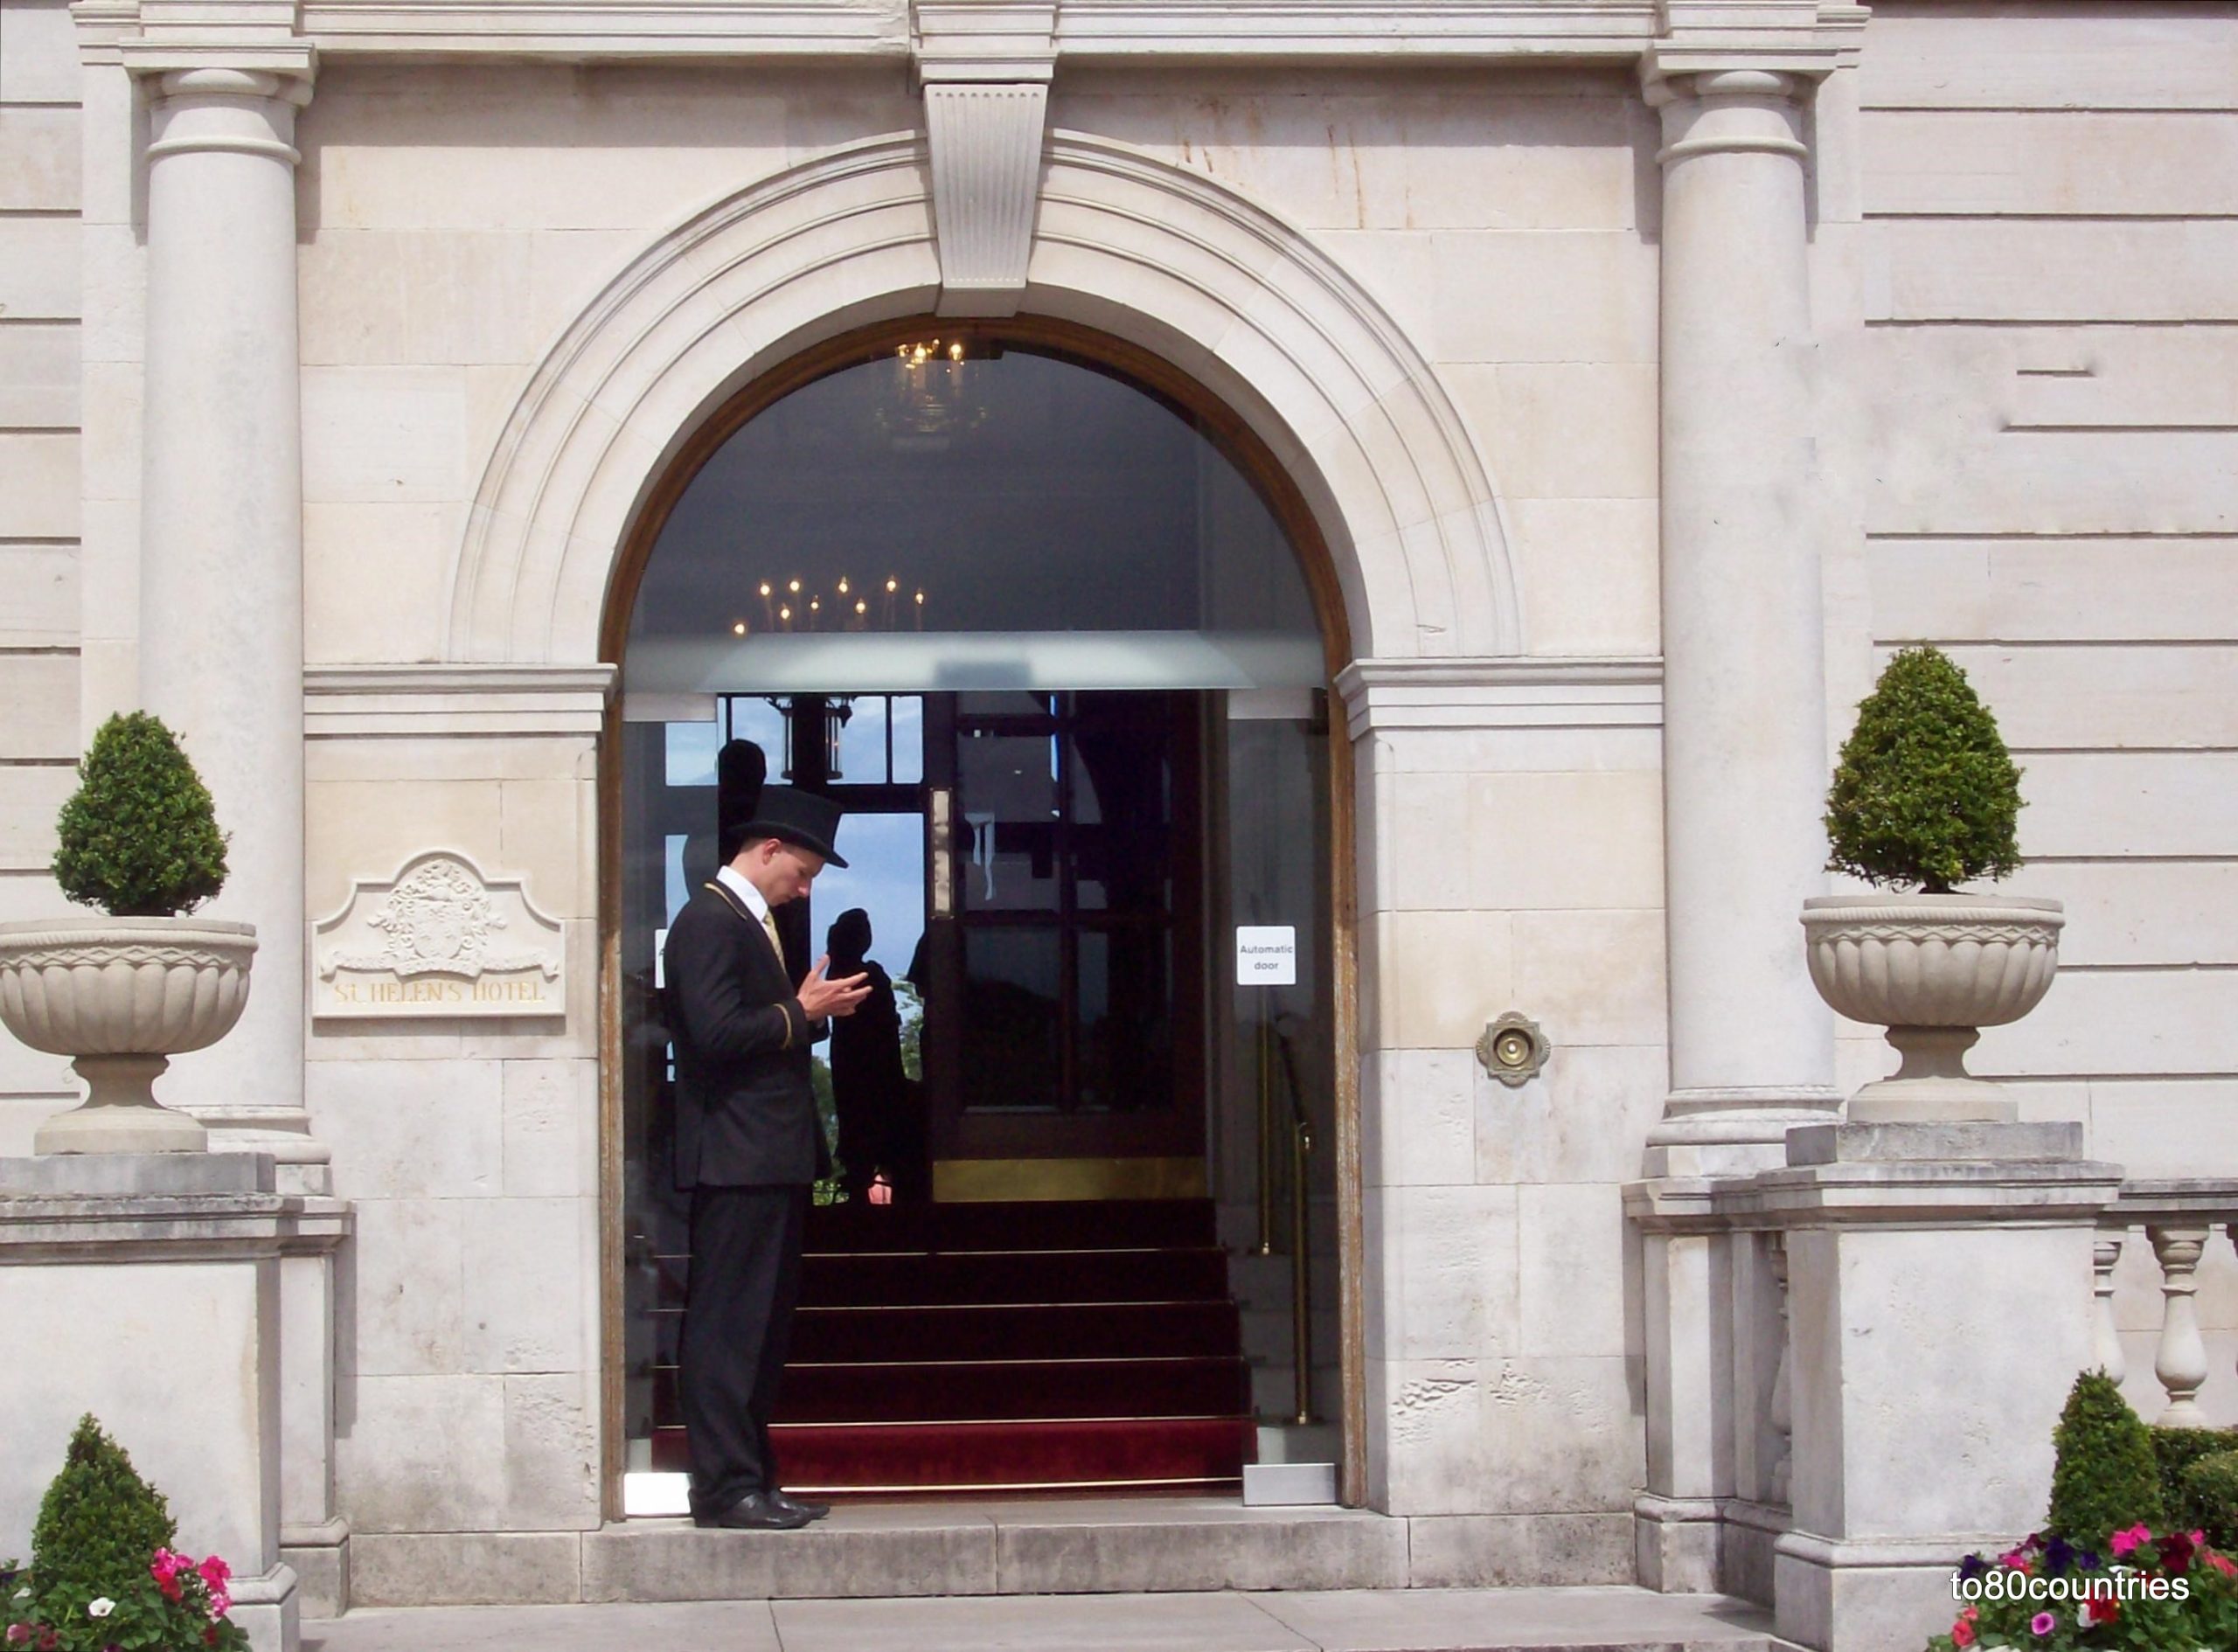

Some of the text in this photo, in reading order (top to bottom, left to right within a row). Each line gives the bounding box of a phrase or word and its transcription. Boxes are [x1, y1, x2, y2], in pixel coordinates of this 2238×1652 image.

[1240, 945, 1293, 954] Automatic
[1254, 961, 1279, 970] door
[473, 981, 546, 1003] HOTEL
